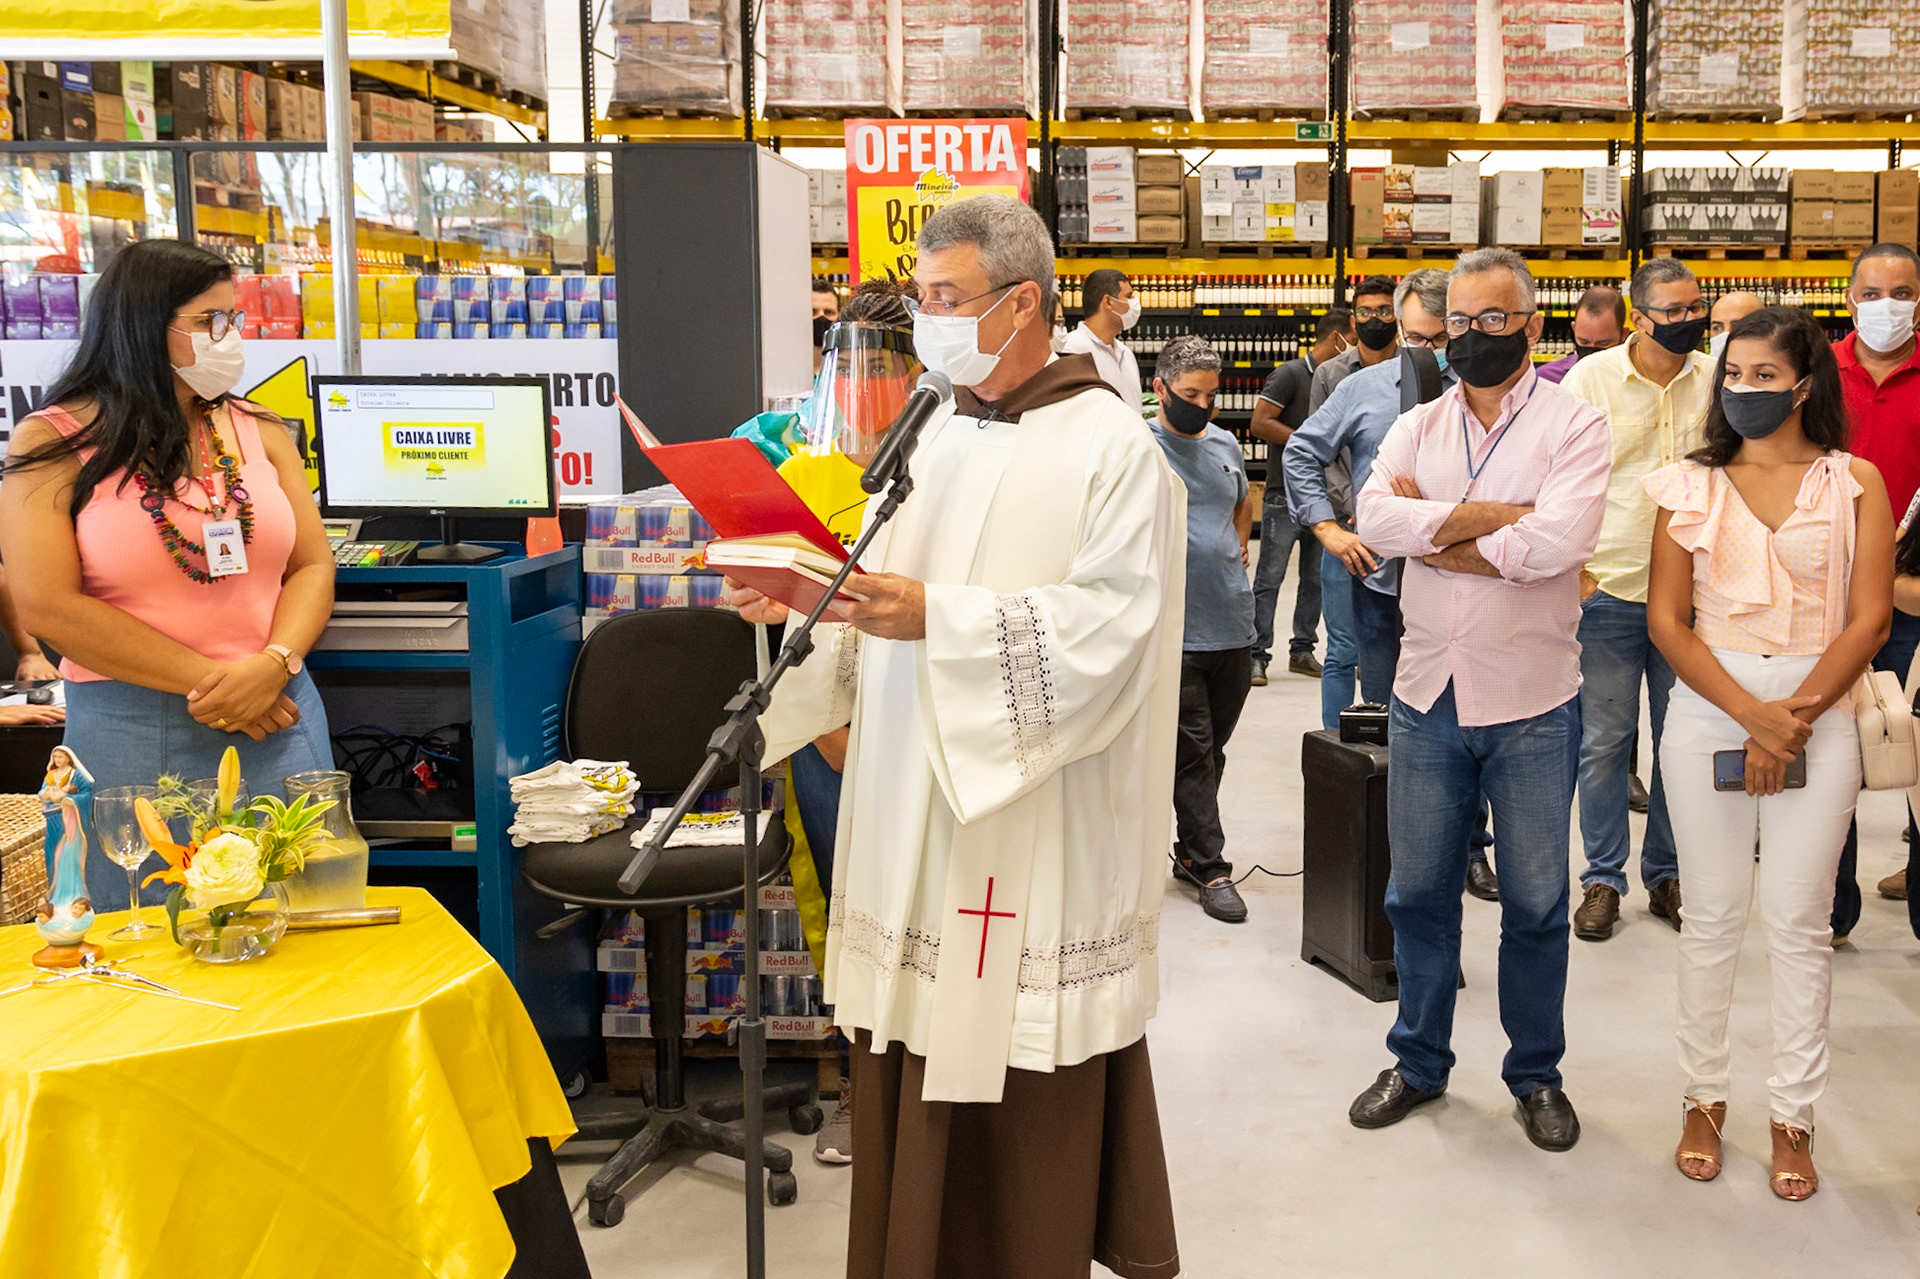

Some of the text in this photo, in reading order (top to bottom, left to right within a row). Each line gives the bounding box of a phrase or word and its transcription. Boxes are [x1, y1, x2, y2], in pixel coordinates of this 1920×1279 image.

[855, 125, 1018, 173] OFERTA
[514, 373, 615, 407] RTO
[396, 431, 471, 445] CAIXA LIVRE
[401, 450, 468, 460] PRÓXIMO CLIENTE
[591, 525, 631, 536] Red Bull
[645, 525, 685, 536] Red Bull
[631, 552, 675, 563] Red Bull
[591, 594, 630, 605] Red Bull
[644, 595, 683, 606] Red Bull
[697, 596, 731, 606] Red Bu
[725, 798, 740, 807] Bul
[764, 889, 785, 900] Red
[731, 929, 745, 937] Bul
[766, 955, 809, 966] Red Bull
[735, 994, 746, 1003] Bu
[772, 1020, 815, 1031] Red Bull
